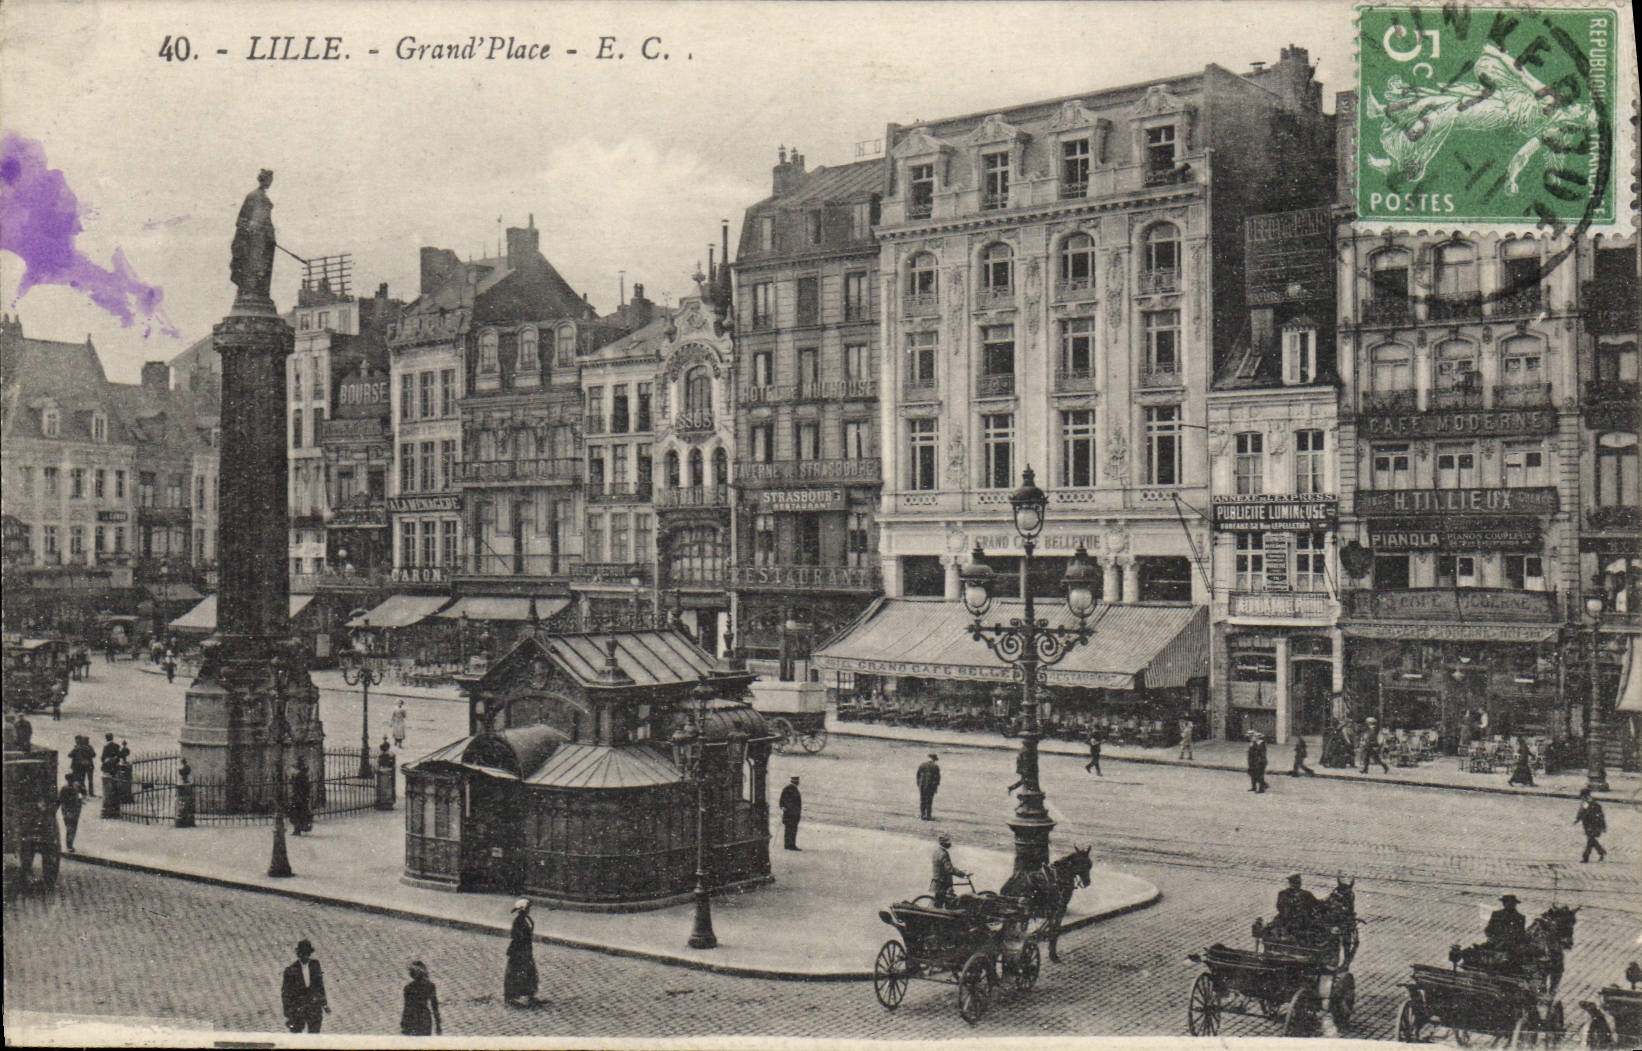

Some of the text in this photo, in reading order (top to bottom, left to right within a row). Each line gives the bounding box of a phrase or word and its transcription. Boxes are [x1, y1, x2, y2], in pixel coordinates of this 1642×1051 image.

[1370, 193, 1455, 212] POSTES
[340, 382, 389, 404] BOURSE
[1437, 412, 1542, 431] MODERNE
[763, 490, 841, 503] STRASBOURG
[1269, 504, 1326, 519] LUMINEUSE
[975, 535, 1009, 549] GRAND
[1014, 535, 1041, 549] CAE
[1371, 533, 1440, 546] PIANOLA
[391, 568, 441, 582] CARON
[858, 660, 906, 673] GRAND
